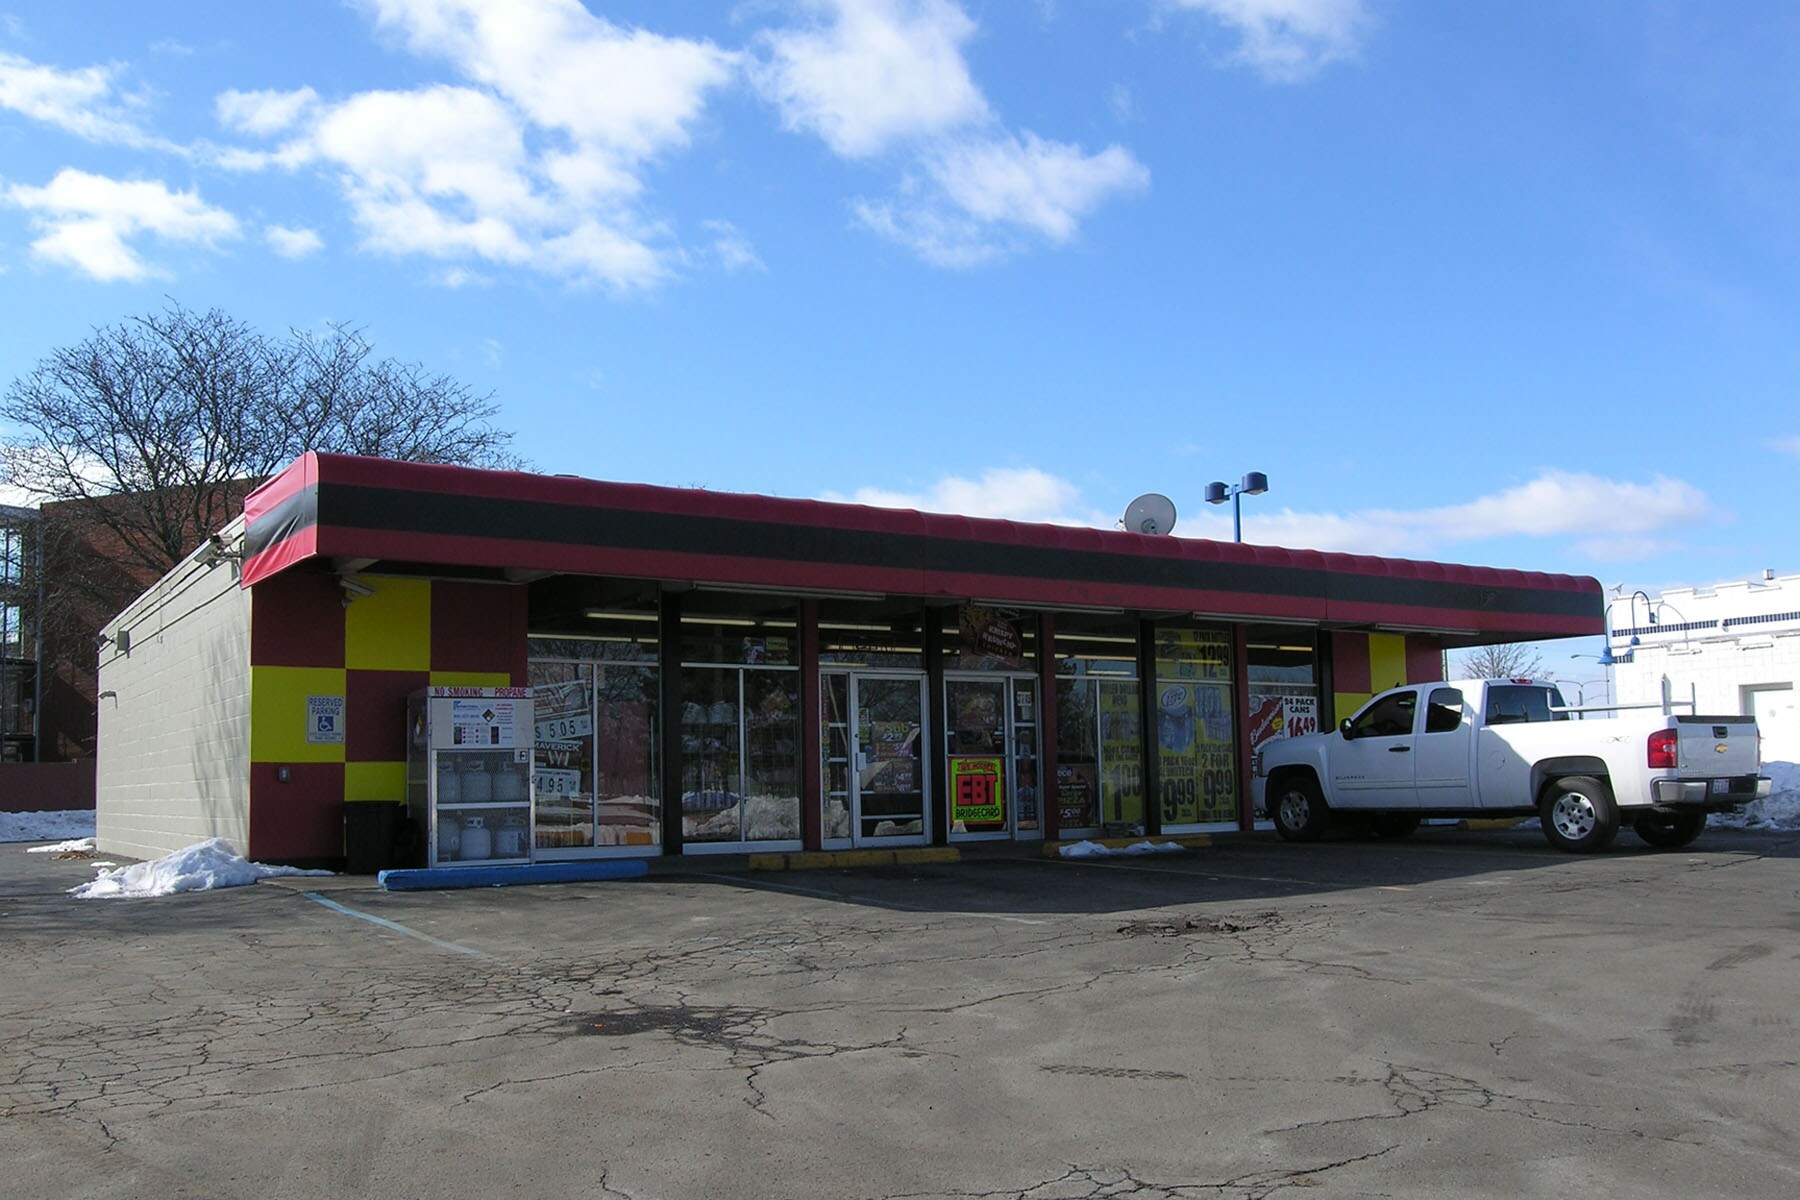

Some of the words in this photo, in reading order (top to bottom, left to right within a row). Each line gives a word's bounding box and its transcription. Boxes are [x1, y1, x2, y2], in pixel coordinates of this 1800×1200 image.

[434, 687, 446, 697] NO
[448, 687, 484, 697] SMOKING
[494, 687, 527, 698] PROPANE
[308, 697, 343, 707] RESERVED
[1296, 698, 1315, 706] PACK
[311, 706, 340, 716] PARKING
[534, 742, 581, 752] MAVERICK
[1201, 753, 1209, 768] 2
[1210, 753, 1230, 769] FOR
[956, 774, 999, 807] EBT
[955, 808, 1000, 818] BRIDGECARD
